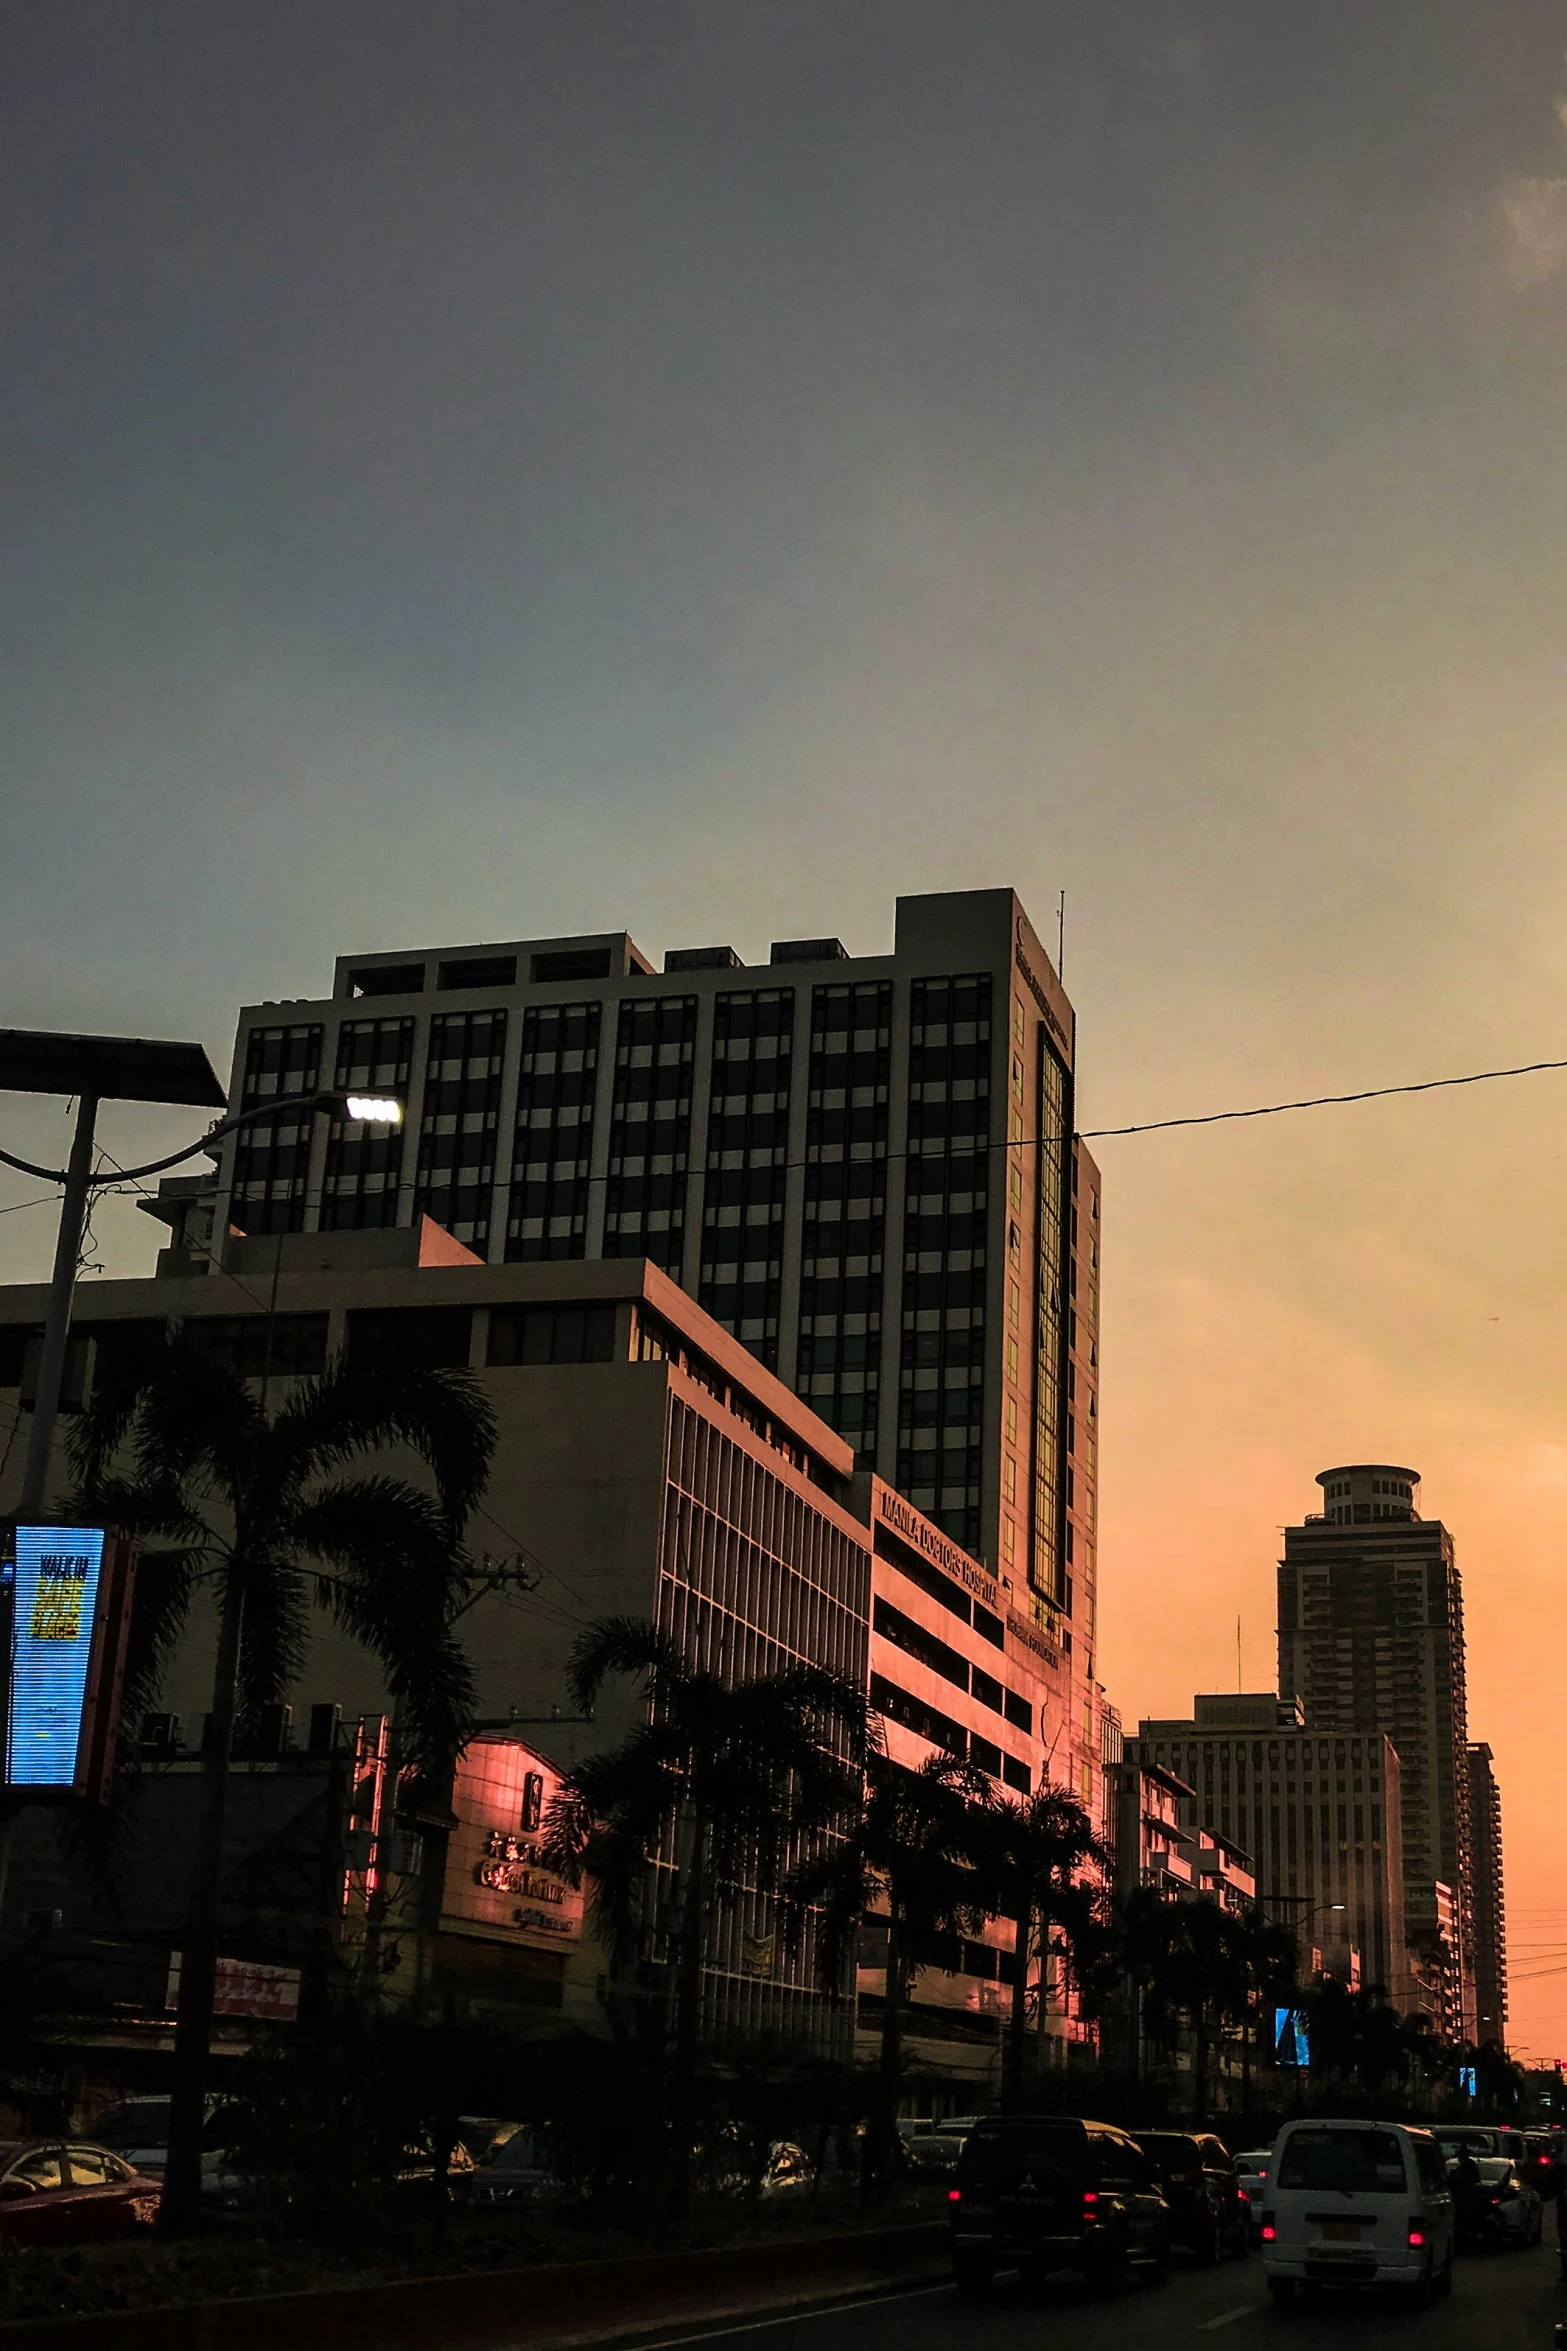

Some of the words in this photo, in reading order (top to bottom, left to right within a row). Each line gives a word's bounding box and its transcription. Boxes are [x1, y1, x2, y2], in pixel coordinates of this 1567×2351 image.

[882, 1492, 919, 1544] MANILA
[919, 1524, 961, 1579] DOCTORS
[961, 1560, 999, 1610] HOSPITAL
[999, 2195, 1057, 2207] PAJERO
